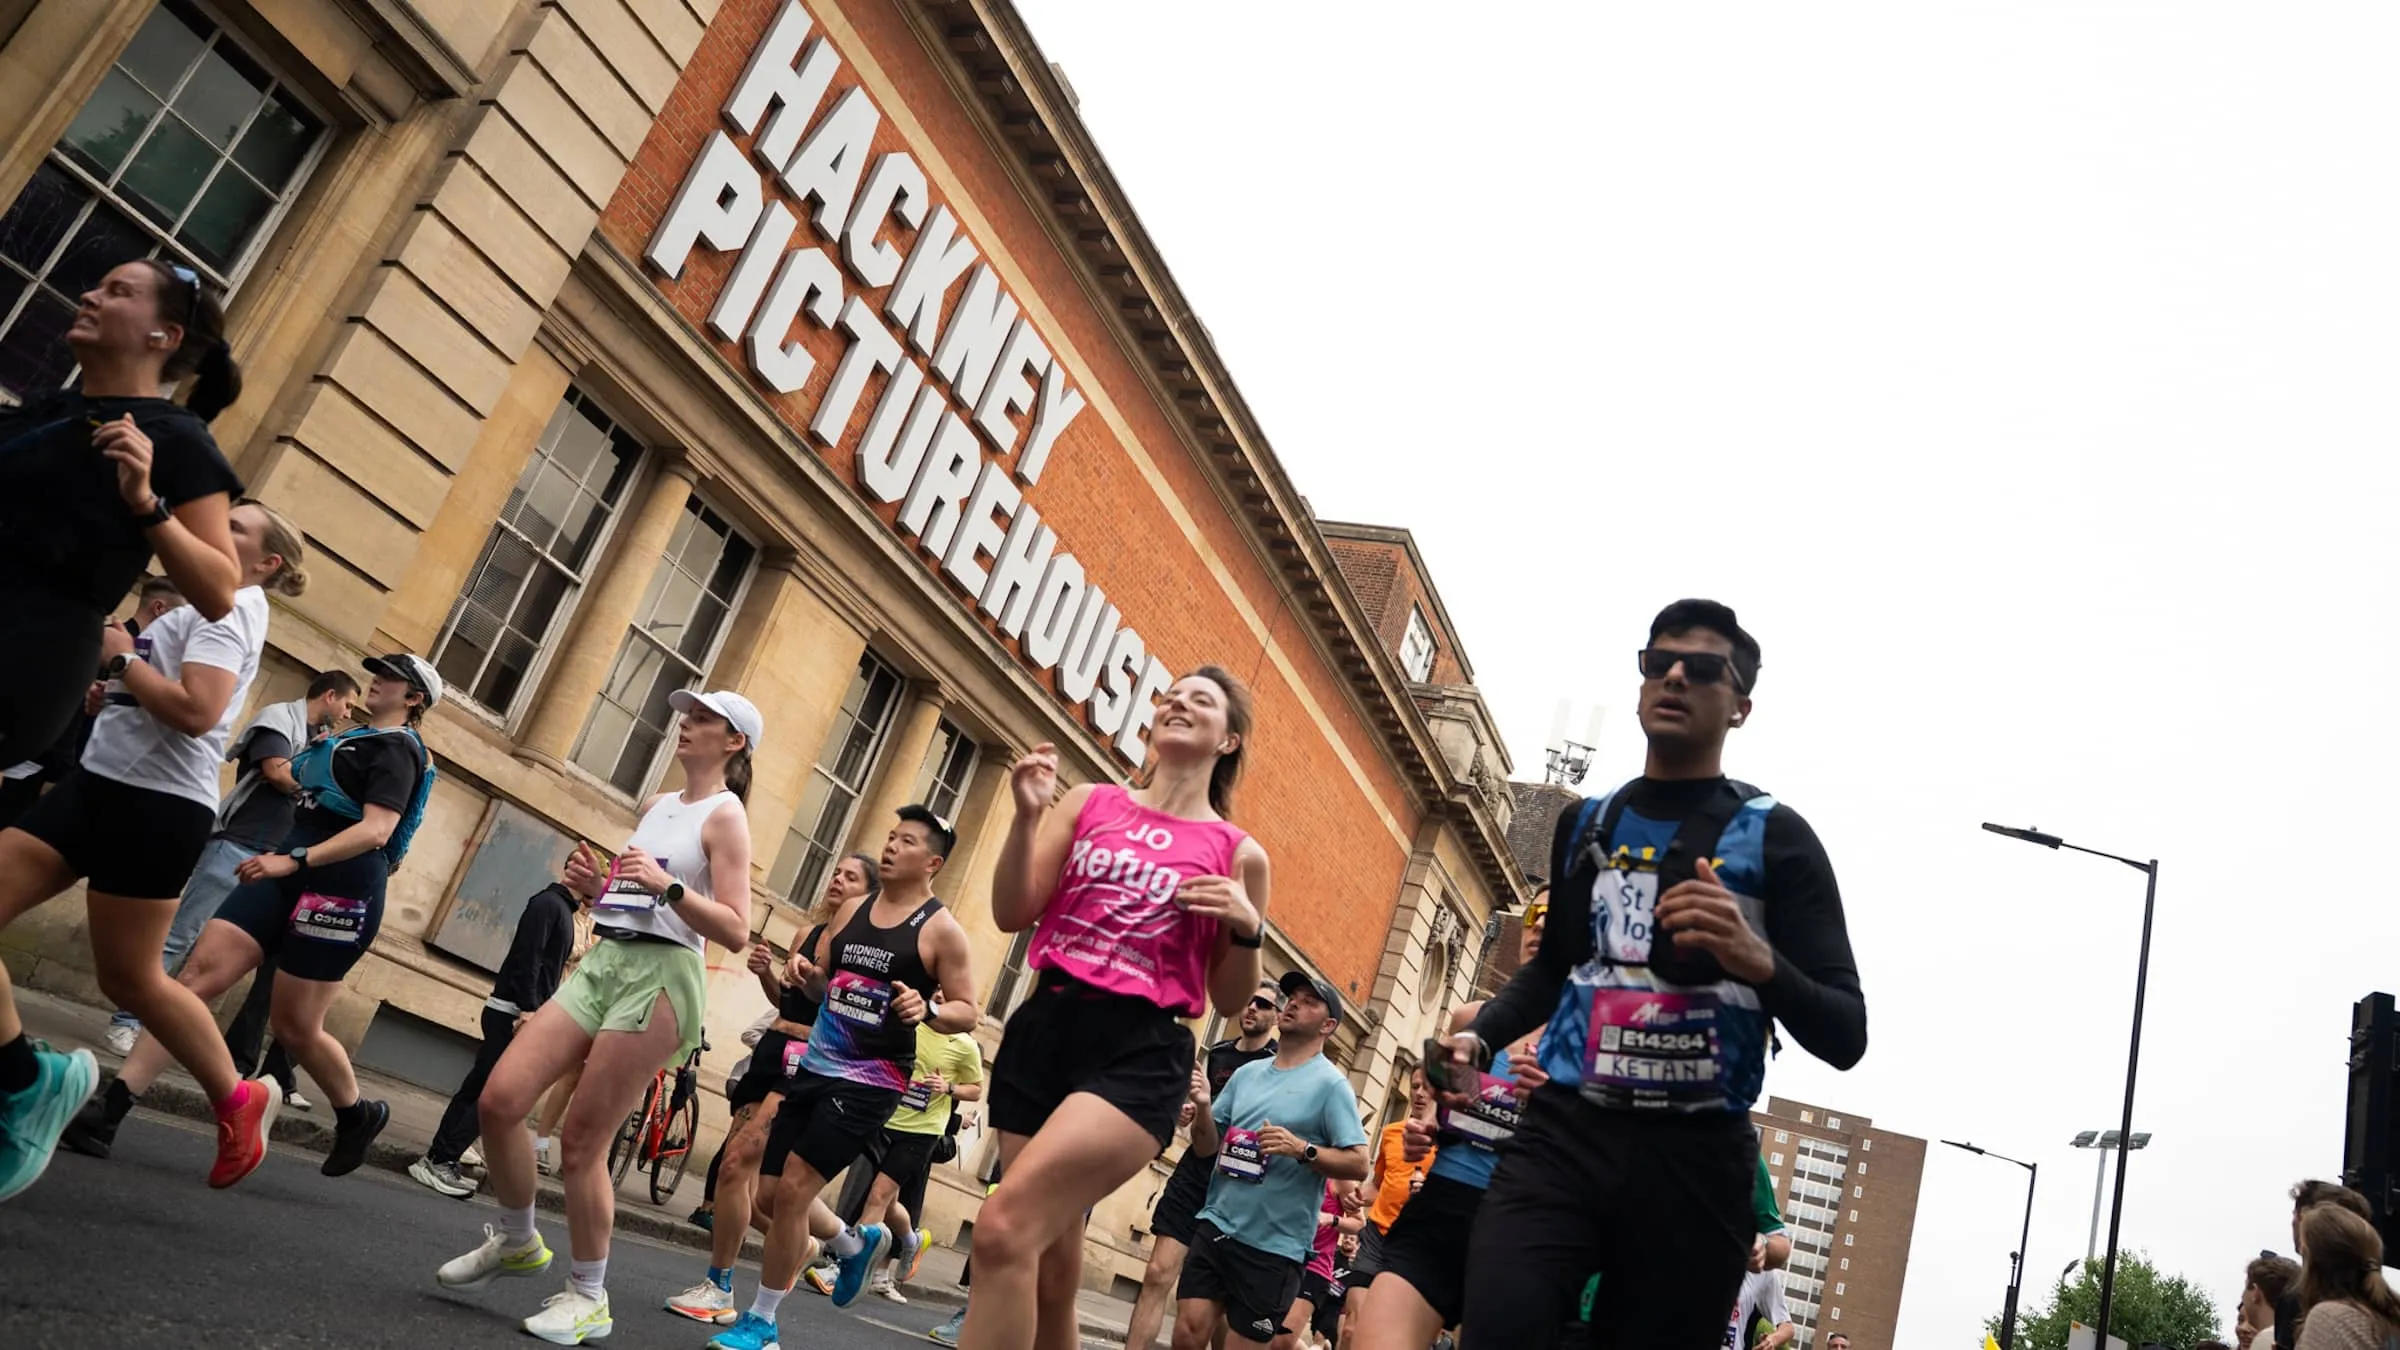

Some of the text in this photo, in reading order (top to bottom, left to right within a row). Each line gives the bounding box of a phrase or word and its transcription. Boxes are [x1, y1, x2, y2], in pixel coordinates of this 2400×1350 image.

[721, 0, 1086, 488] HACKNEY
[643, 129, 1174, 769] PICTUREHOUSE
[1124, 822, 1174, 851] JO
[1066, 839, 1183, 905] Refug
[1620, 884, 1644, 911] St
[841, 953, 891, 973] RUNNERS
[842, 943, 896, 963] MIDNIGHT
[1621, 1028, 1706, 1050] E14264
[1611, 1055, 1700, 1081] KETAN
